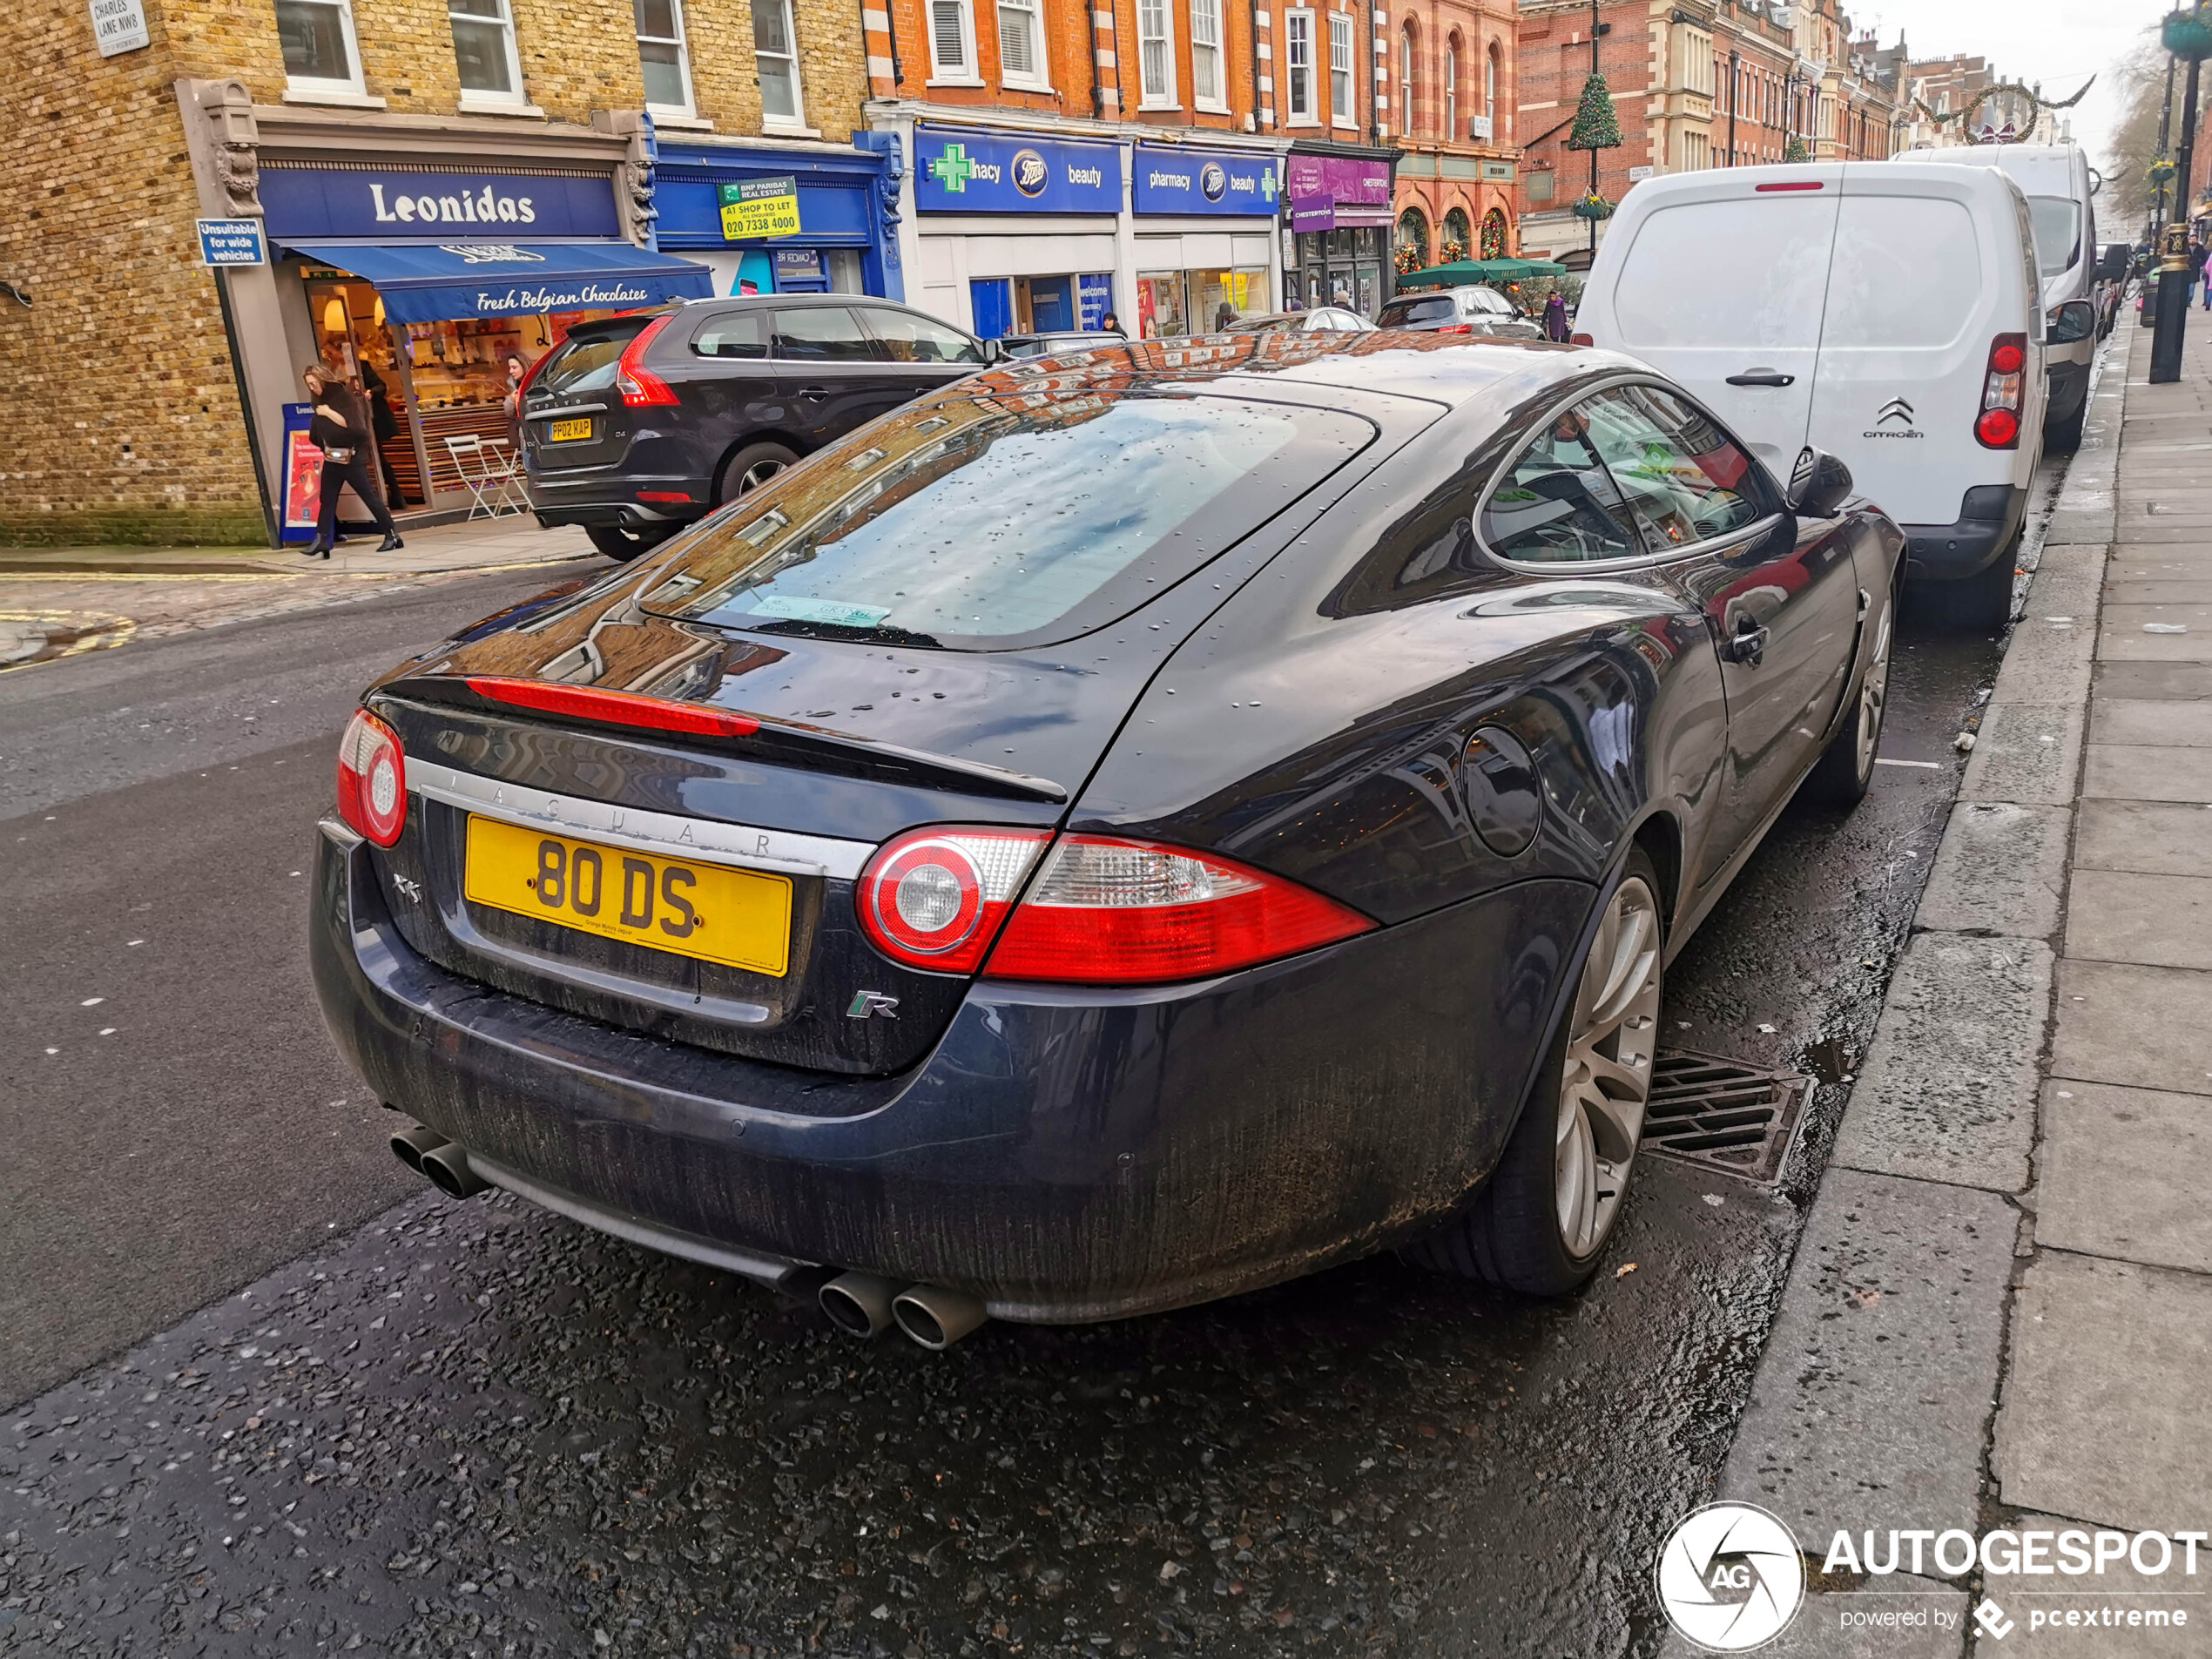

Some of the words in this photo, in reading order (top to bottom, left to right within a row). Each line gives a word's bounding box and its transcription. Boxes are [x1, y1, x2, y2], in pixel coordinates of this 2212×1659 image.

[94, 0, 127, 20] CHARLES
[98, 19, 118, 37] LANE
[118, 13, 138, 31] NW8
[1020, 159, 1046, 186] Boots
[1068, 164, 1102, 189] beauty
[1150, 169, 1190, 192] pharmacy
[1231, 173, 1255, 194] beauty
[757, 181, 787, 191] PARIBAS
[760, 188, 786, 197] ESTATE
[368, 184, 536, 224] Leonidas
[726, 206, 737, 215] A1
[739, 205, 761, 214] SHOP
[777, 202, 791, 211] LET
[1295, 209, 1332, 219] CHESTERTONS
[200, 223, 258, 235] Unsuitable
[726, 221, 744, 233] 020
[745, 219, 769, 232] 7338
[772, 216, 795, 229] 4000
[210, 236, 226, 248] for
[227, 236, 253, 248] wide
[212, 249, 256, 261] vehicles
[477, 289, 519, 312] Fresh
[520, 287, 581, 314] Belgian
[581, 283, 648, 303] Chocolates
[1079, 286, 1108, 297] welcome
[536, 399, 581, 410] VOLVO
[553, 422, 572, 438] PP02
[574, 420, 590, 435] KAP
[449, 775, 772, 856] JAGUAR
[536, 839, 603, 918] 80
[619, 856, 697, 939] DS
